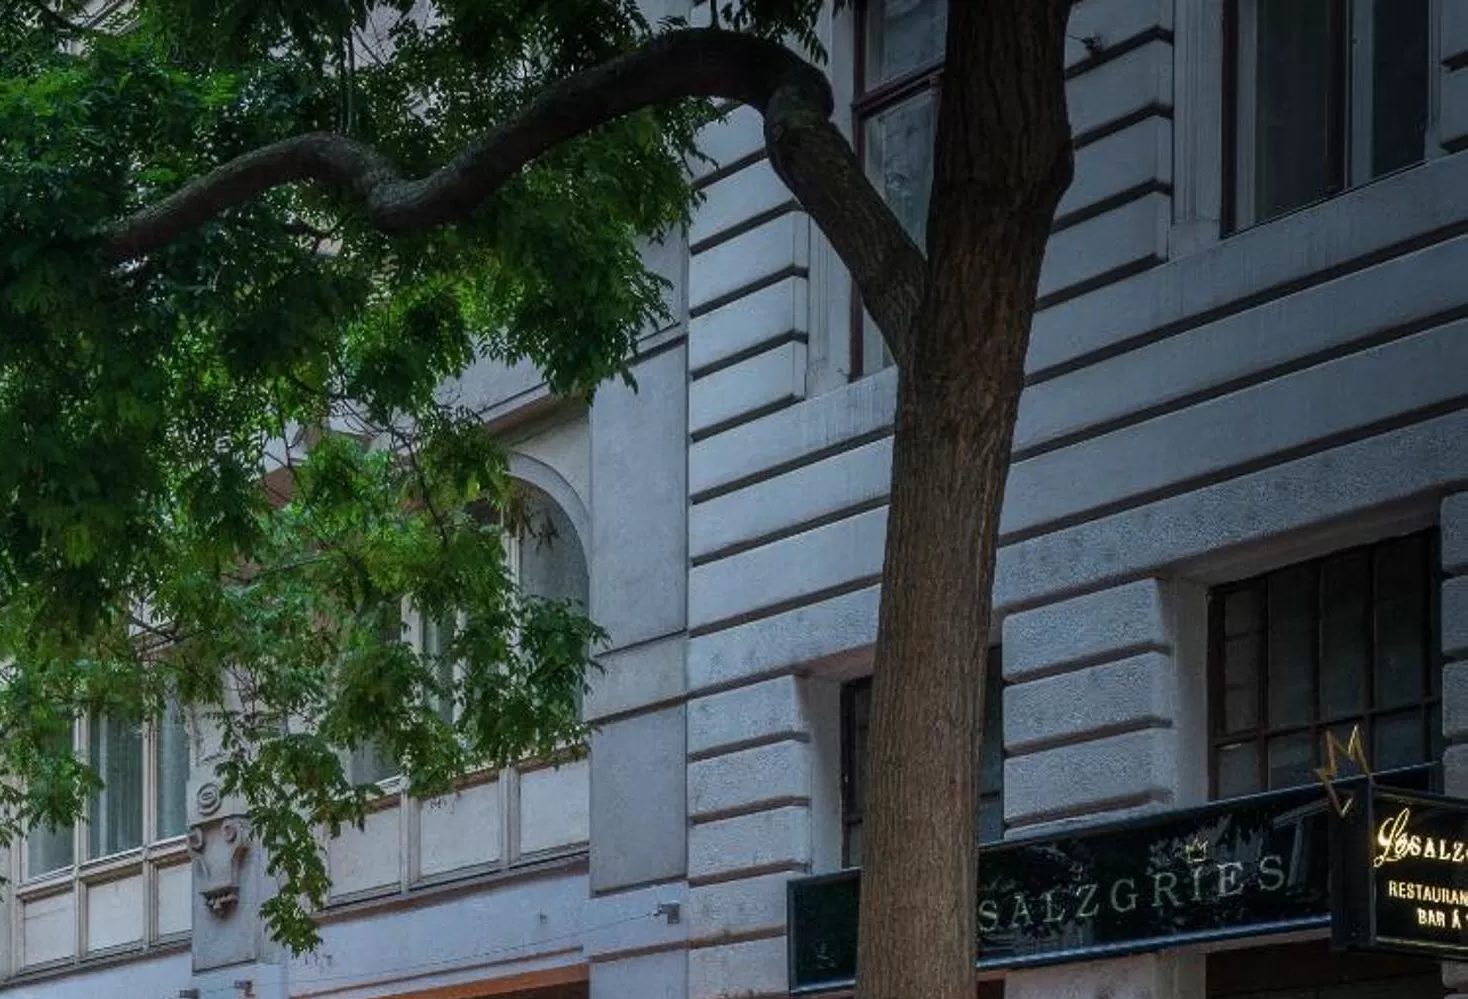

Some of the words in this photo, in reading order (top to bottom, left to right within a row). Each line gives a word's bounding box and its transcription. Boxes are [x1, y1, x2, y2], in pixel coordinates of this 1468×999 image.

[1409, 834, 1468, 863] SALZ
[978, 855, 1286, 933] SALZGRIES
[1388, 880, 1468, 907] RESTAURAN
[1417, 908, 1446, 928] BAR
